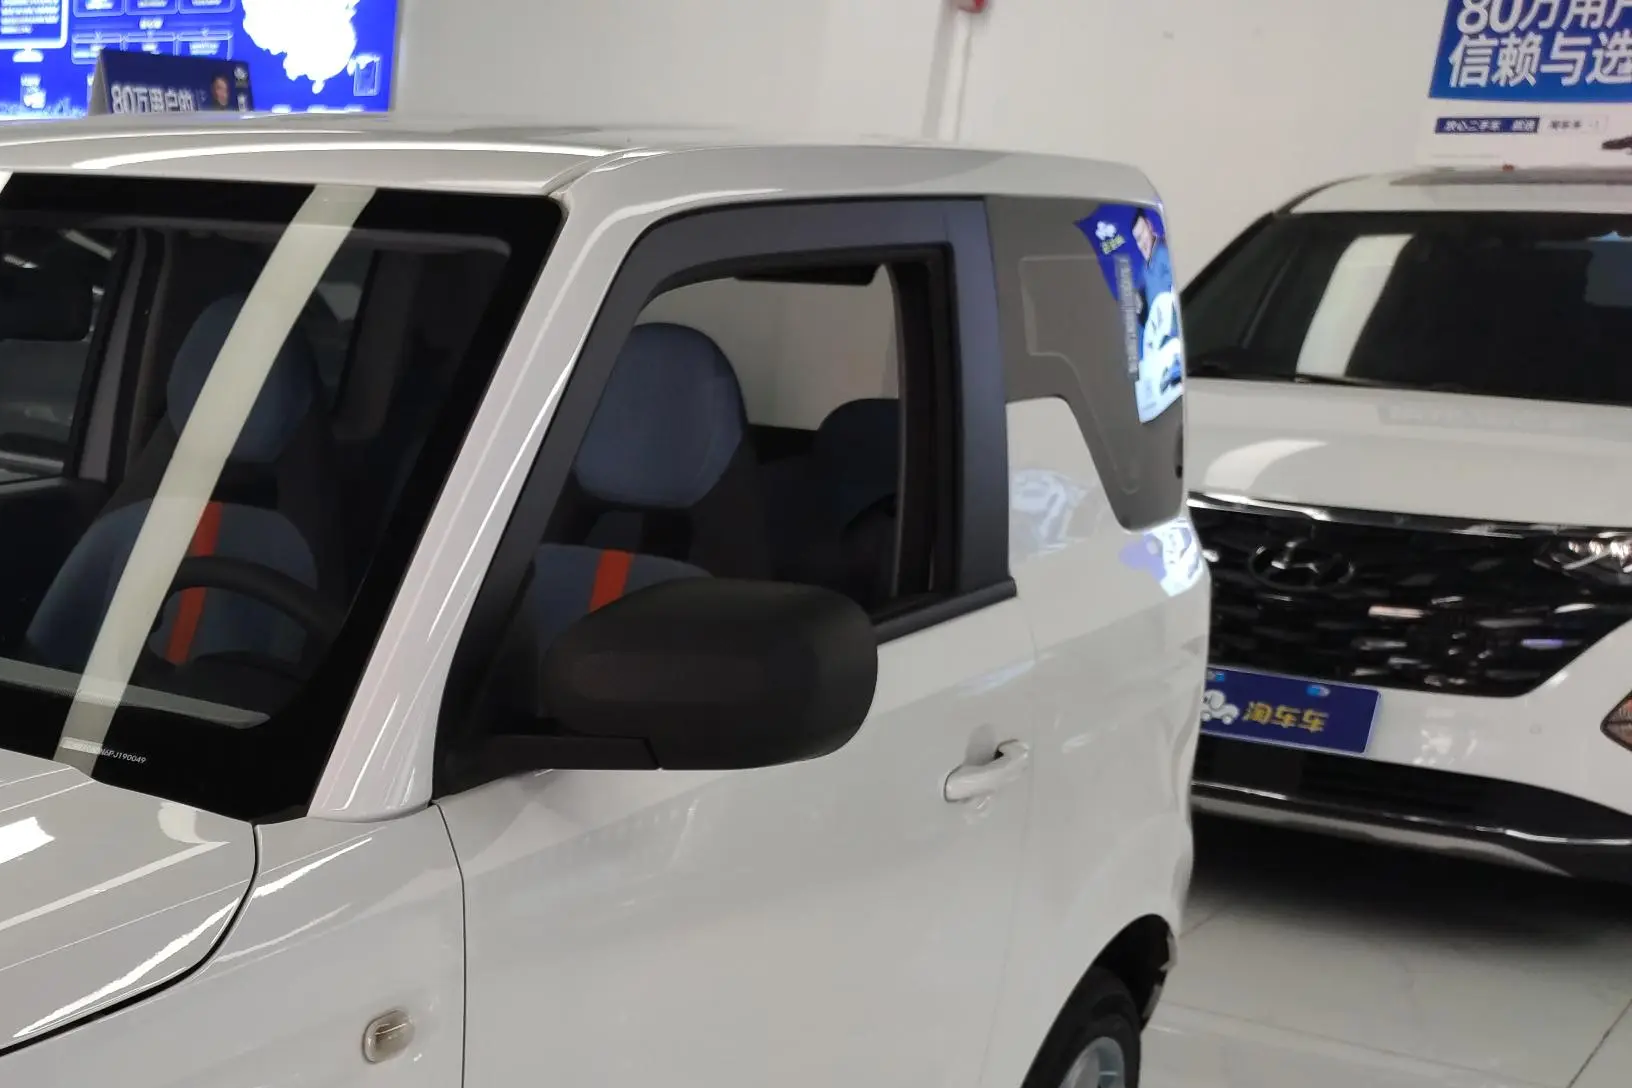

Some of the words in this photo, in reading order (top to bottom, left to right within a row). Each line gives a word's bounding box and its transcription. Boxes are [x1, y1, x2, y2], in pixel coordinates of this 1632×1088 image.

[1448, 30, 1632, 88] 信赖与选
[1242, 702, 1329, 732] 淘车车
